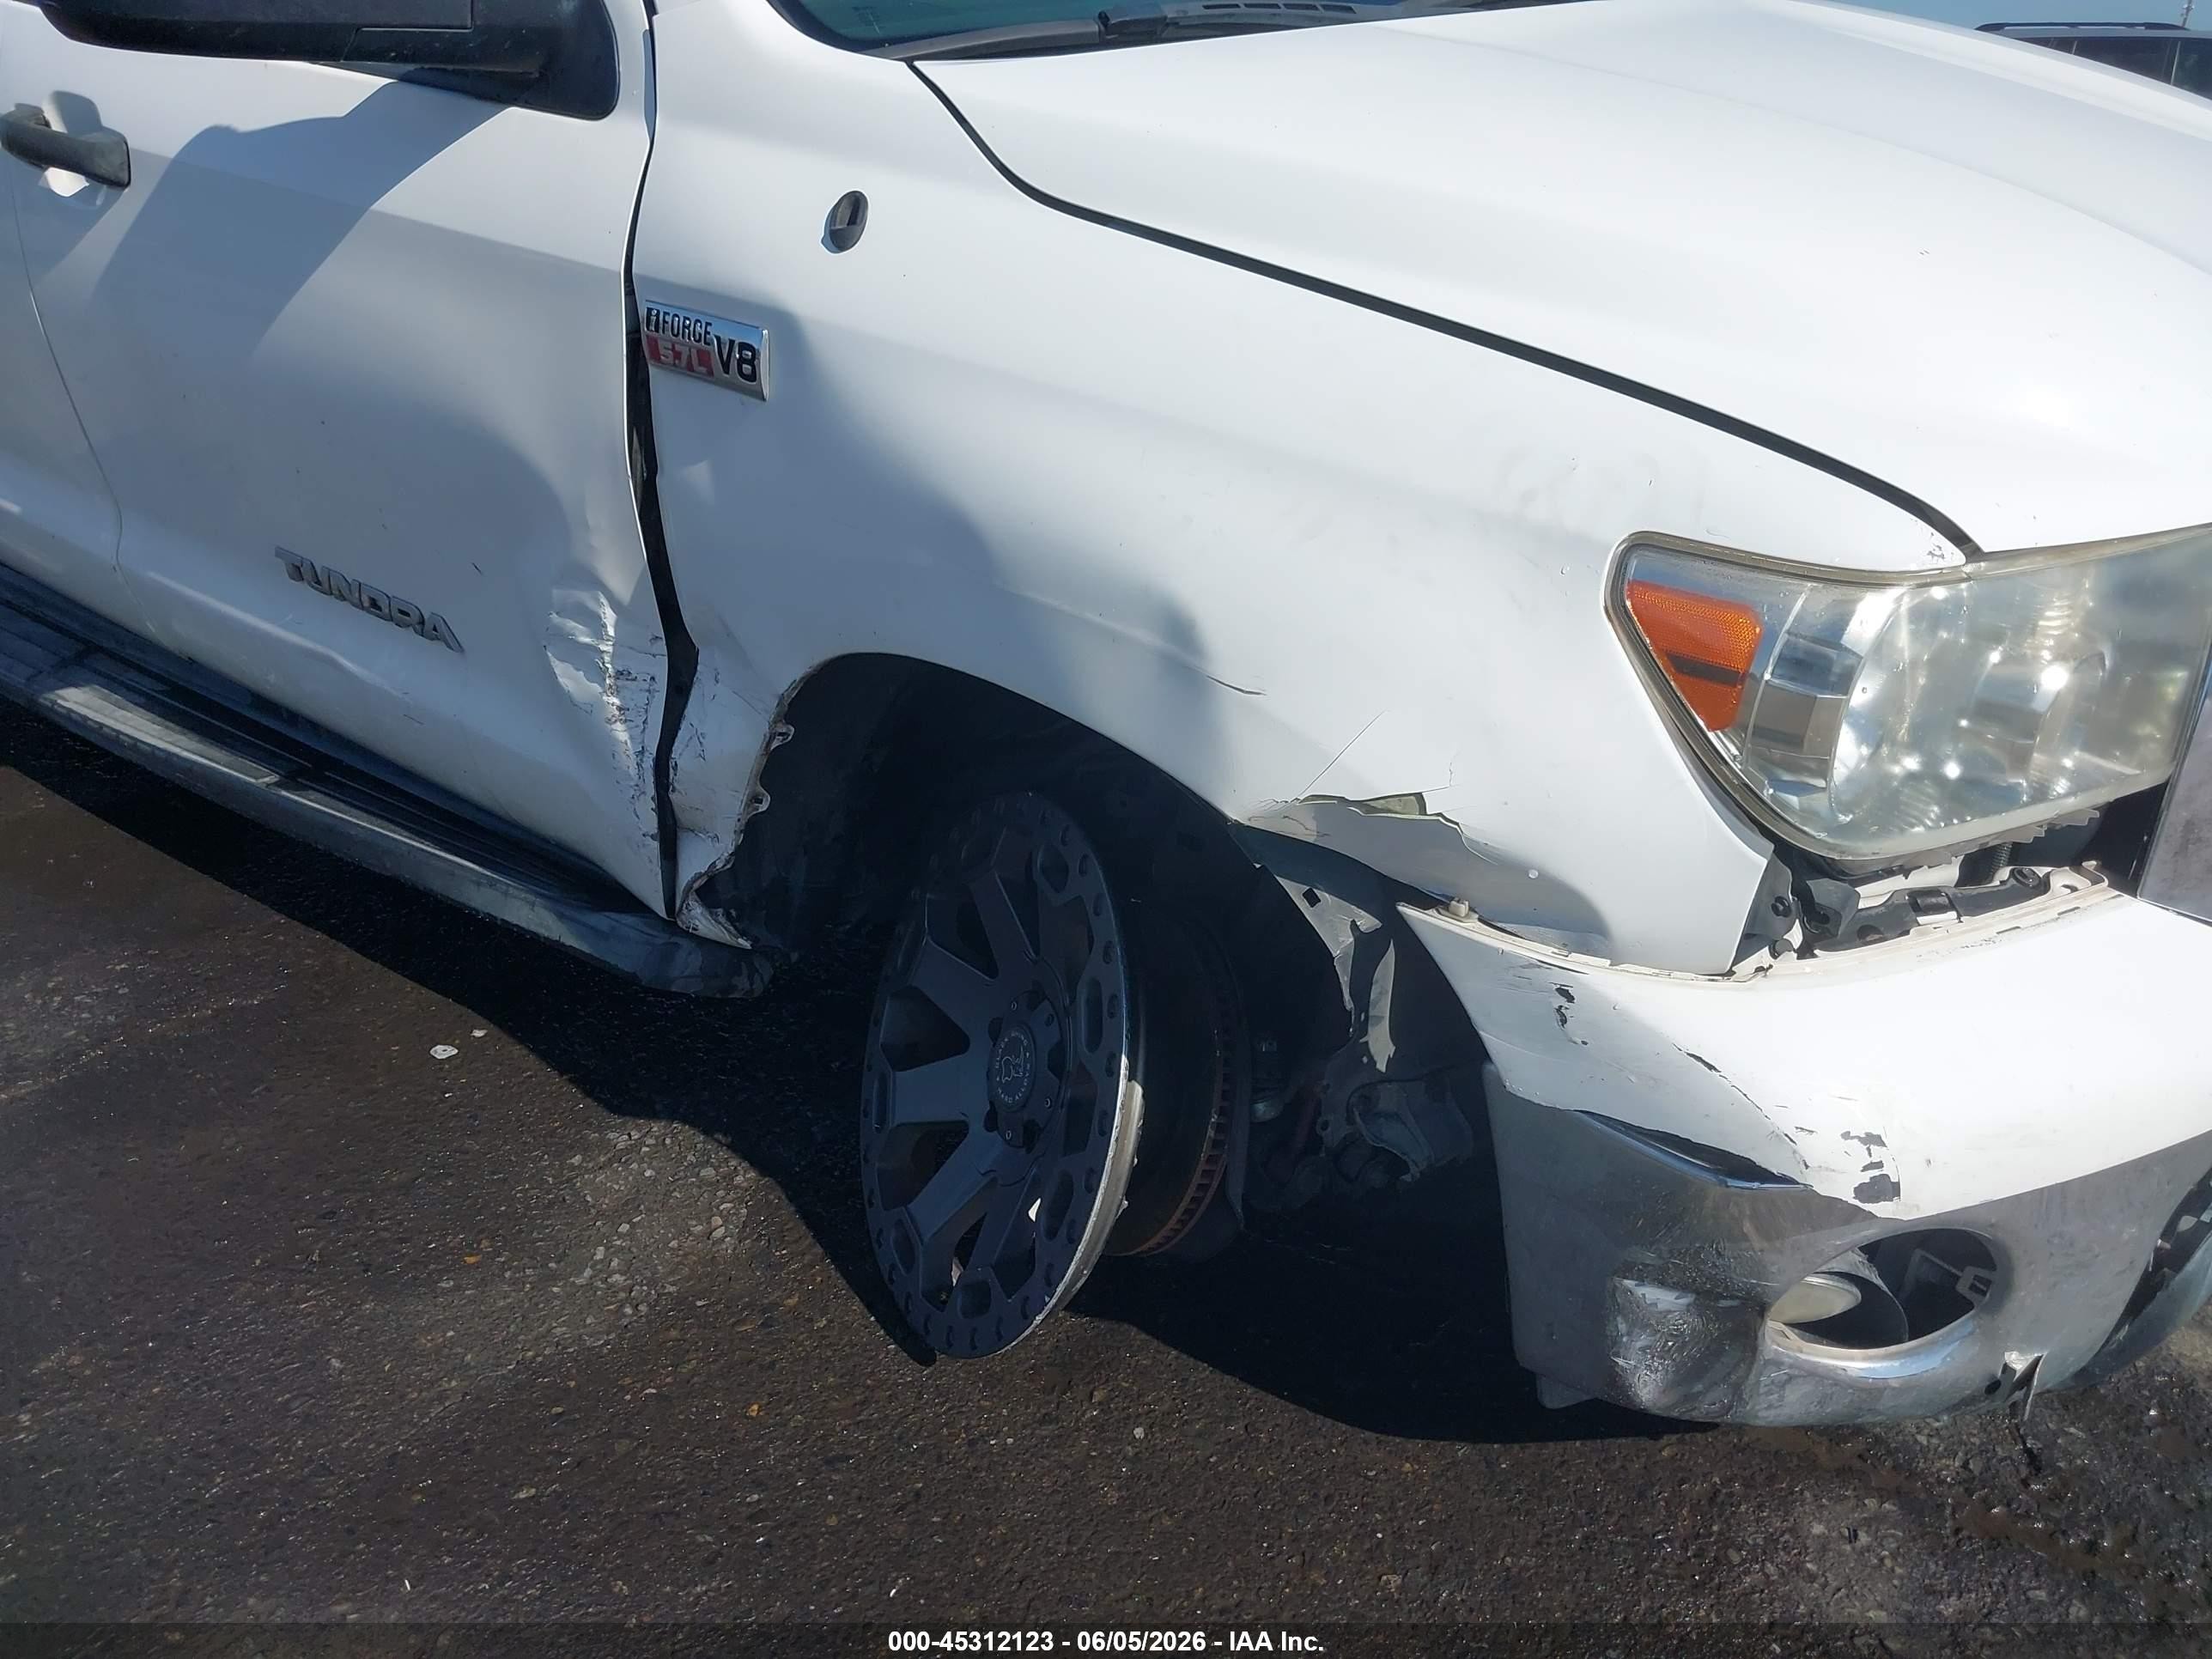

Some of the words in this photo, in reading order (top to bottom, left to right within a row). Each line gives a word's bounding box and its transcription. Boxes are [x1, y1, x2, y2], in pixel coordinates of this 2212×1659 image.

[659, 341, 708, 373] 5.7L
[713, 334, 757, 383] V8
[274, 546, 465, 653] TUNDRA
